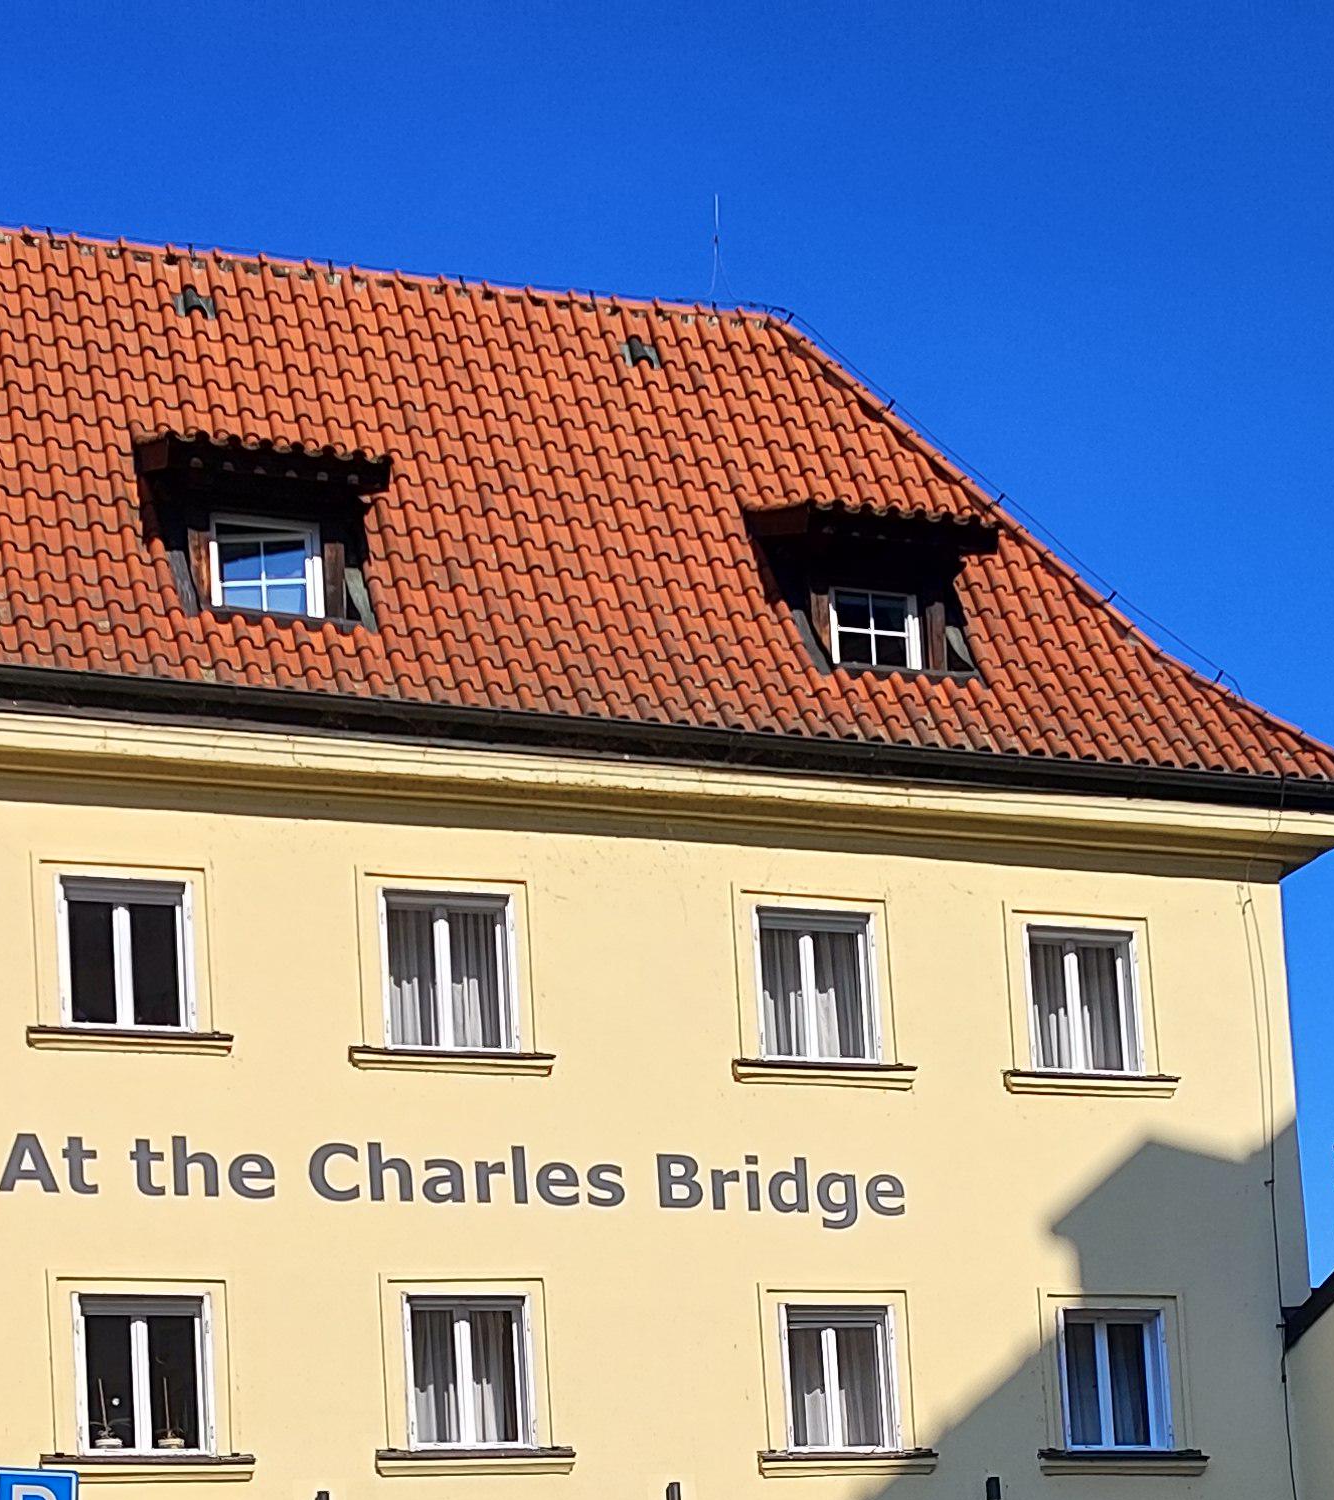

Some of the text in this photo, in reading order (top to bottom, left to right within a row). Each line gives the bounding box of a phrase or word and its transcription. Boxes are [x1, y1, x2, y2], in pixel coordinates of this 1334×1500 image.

[129, 1135, 276, 1199] the
[308, 1142, 626, 1207] Charles
[656, 1153, 906, 1230] Bridge
